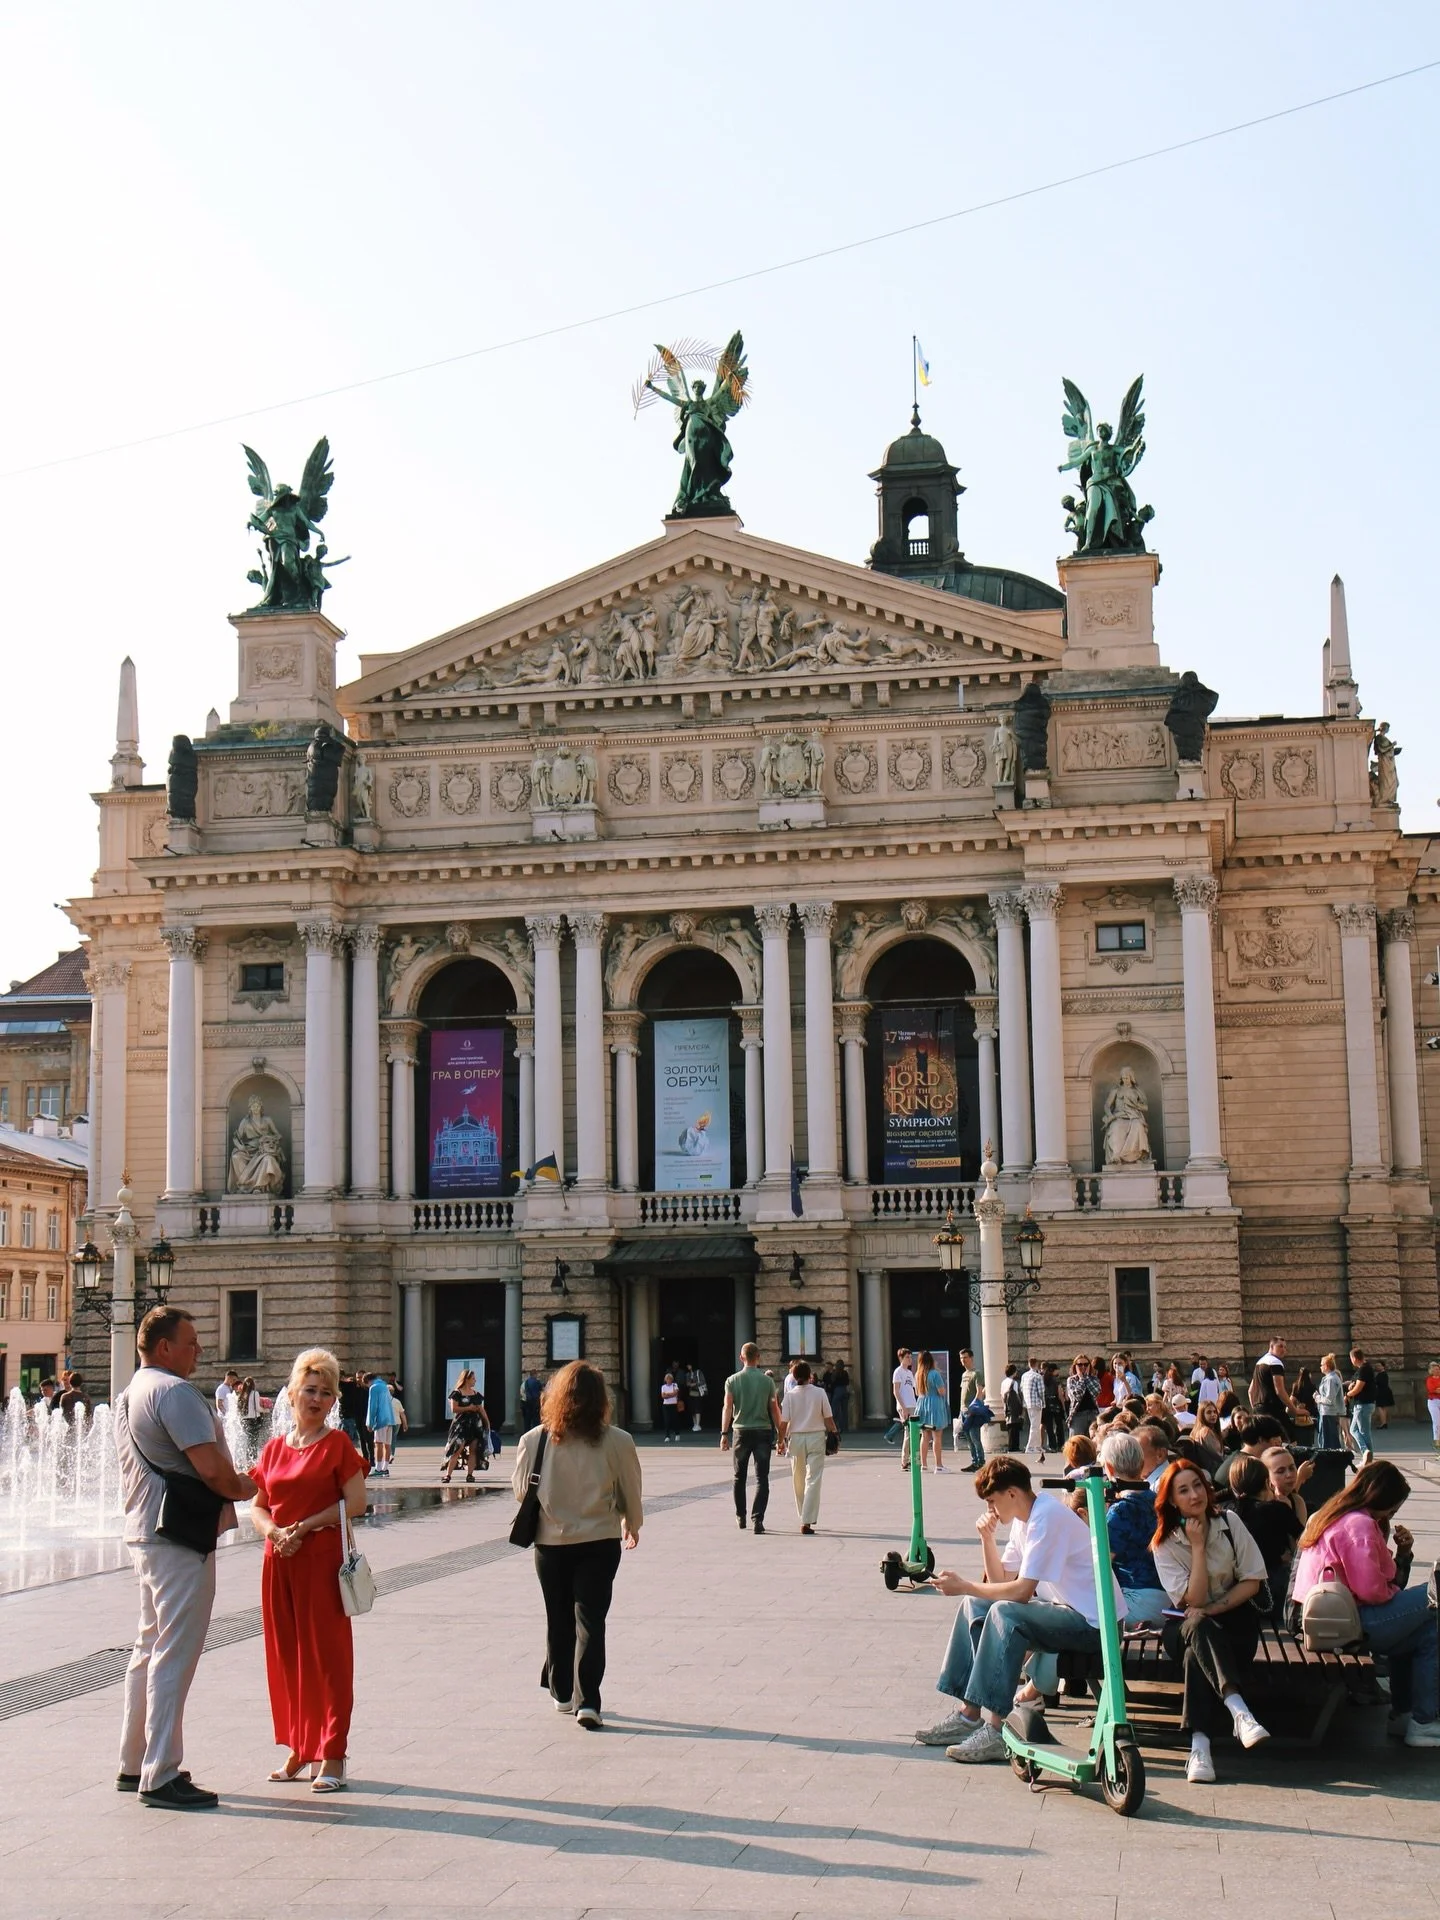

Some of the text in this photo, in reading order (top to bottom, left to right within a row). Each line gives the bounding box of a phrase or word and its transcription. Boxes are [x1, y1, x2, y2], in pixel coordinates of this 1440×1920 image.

[885, 1031, 897, 1043] 17
[664, 1062, 720, 1075] ЗОЛОТИЙ
[432, 1069, 501, 1081] ГРА В ОПЕРУ
[888, 1065, 940, 1090] LORD
[666, 1075, 718, 1088] ОБРУЧ
[889, 1090, 954, 1115] RINGS
[889, 1116, 953, 1128] SYMPHONY
[918, 1129, 957, 1138] ORCHESTRA
